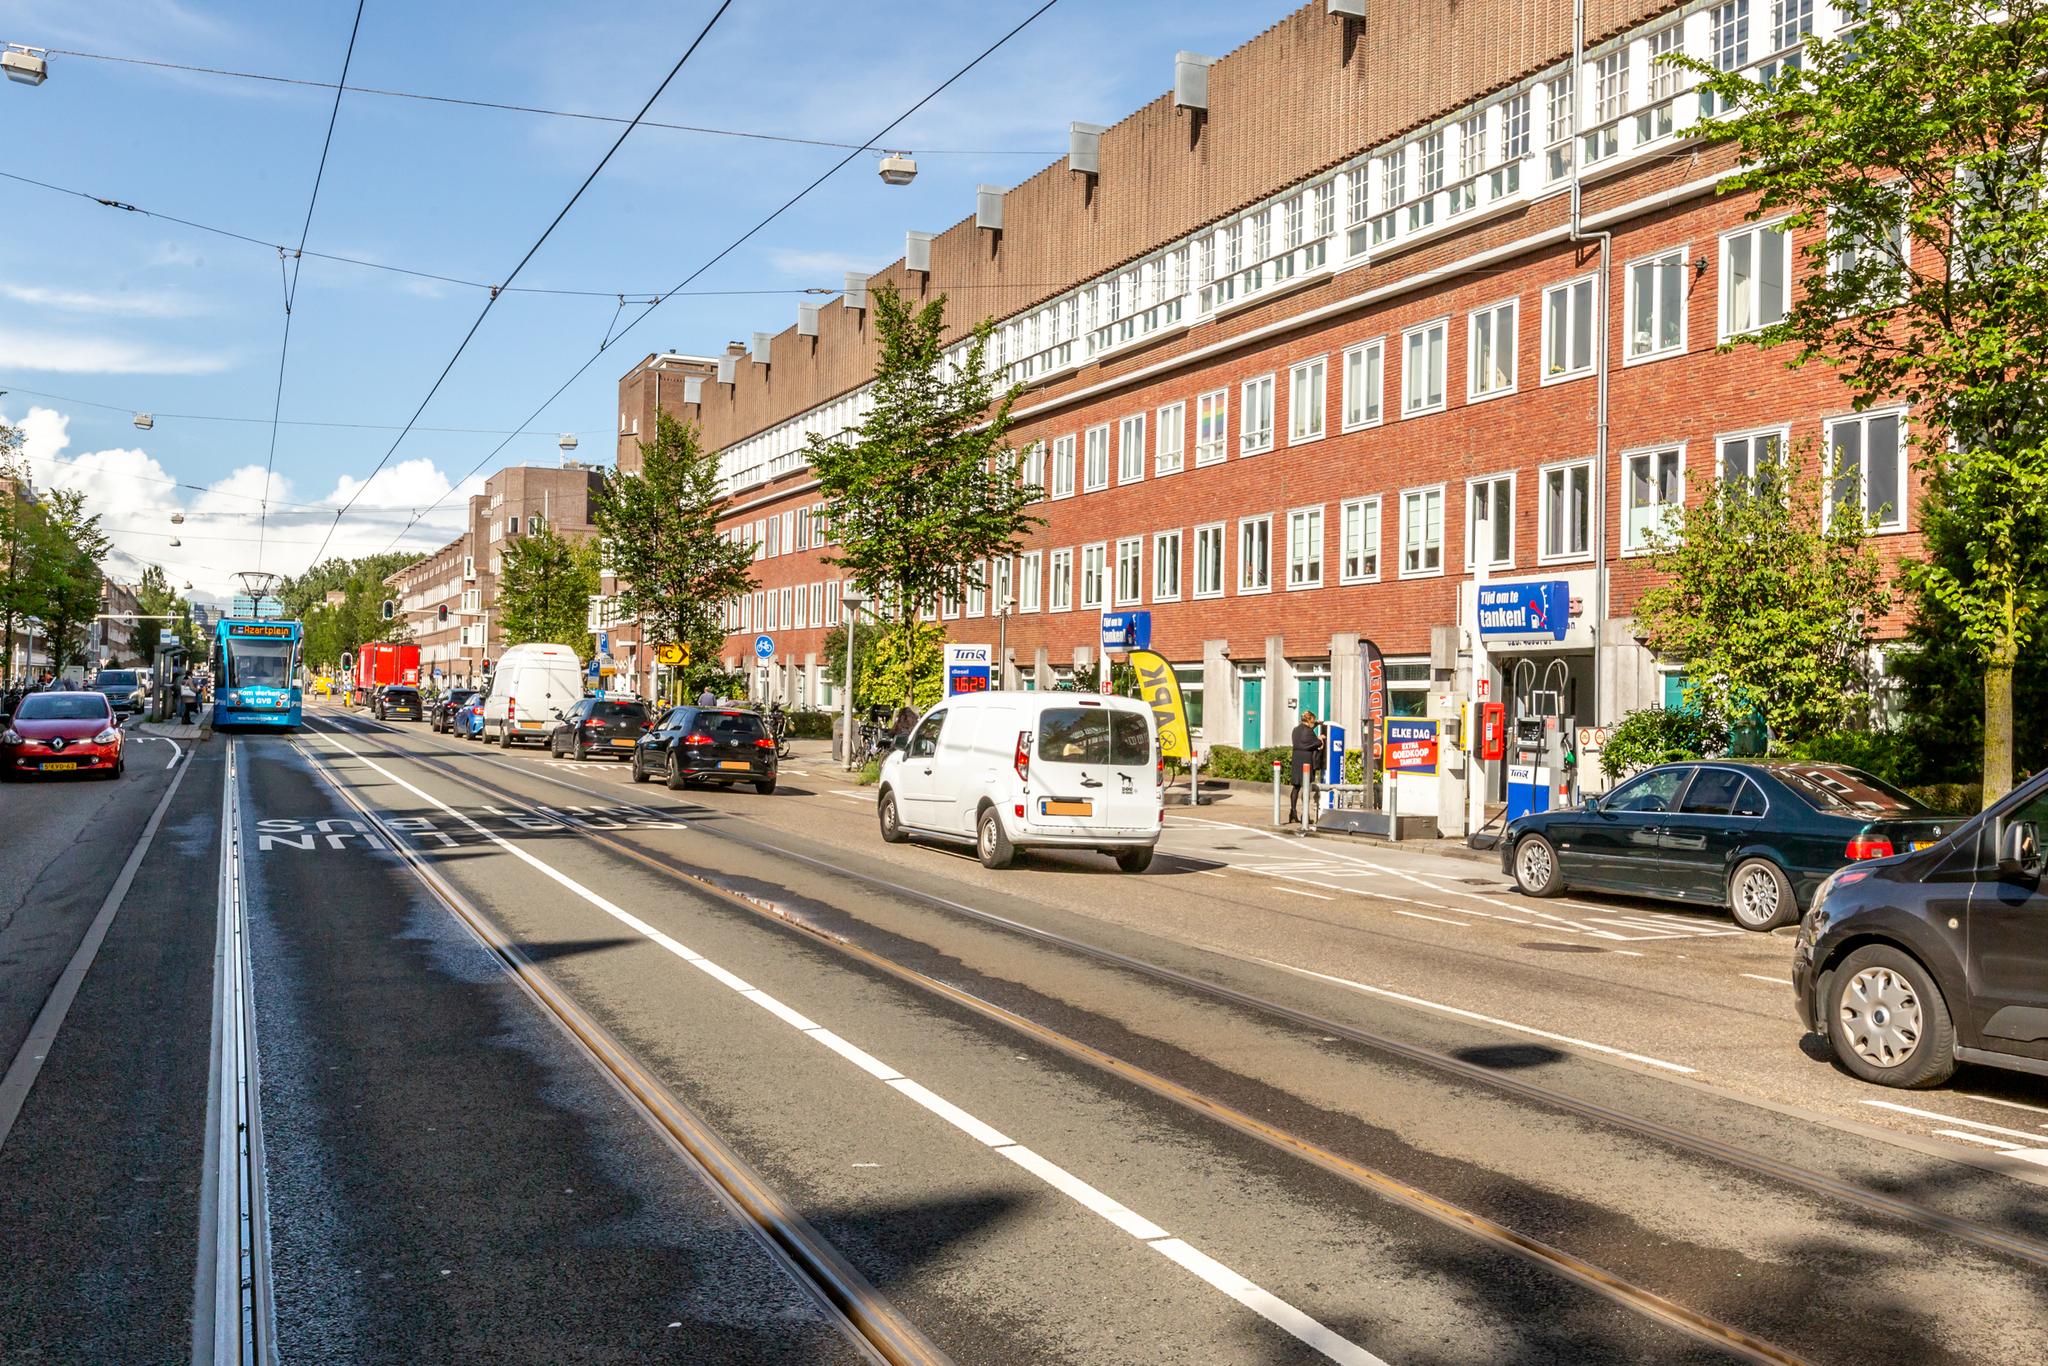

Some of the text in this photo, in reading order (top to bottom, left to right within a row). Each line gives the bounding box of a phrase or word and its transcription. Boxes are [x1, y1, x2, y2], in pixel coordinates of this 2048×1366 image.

[1480, 591, 1519, 606] Tijd om te
[1480, 606, 1527, 629] tanken!
[244, 625, 289, 636] Azartplein
[601, 635, 606, 645] P
[665, 650, 674, 660] C
[591, 662, 599, 671] P
[255, 689, 280, 697] werken
[256, 697, 272, 705] GVB
[1391, 727, 1431, 740] ELKE DAG
[1401, 742, 1419, 750] EXTRA
[1392, 748, 1430, 760] GOEDKOOP
[256, 817, 439, 833] BUS
[506, 817, 688, 830] BUS
[259, 832, 461, 850] LIJN
